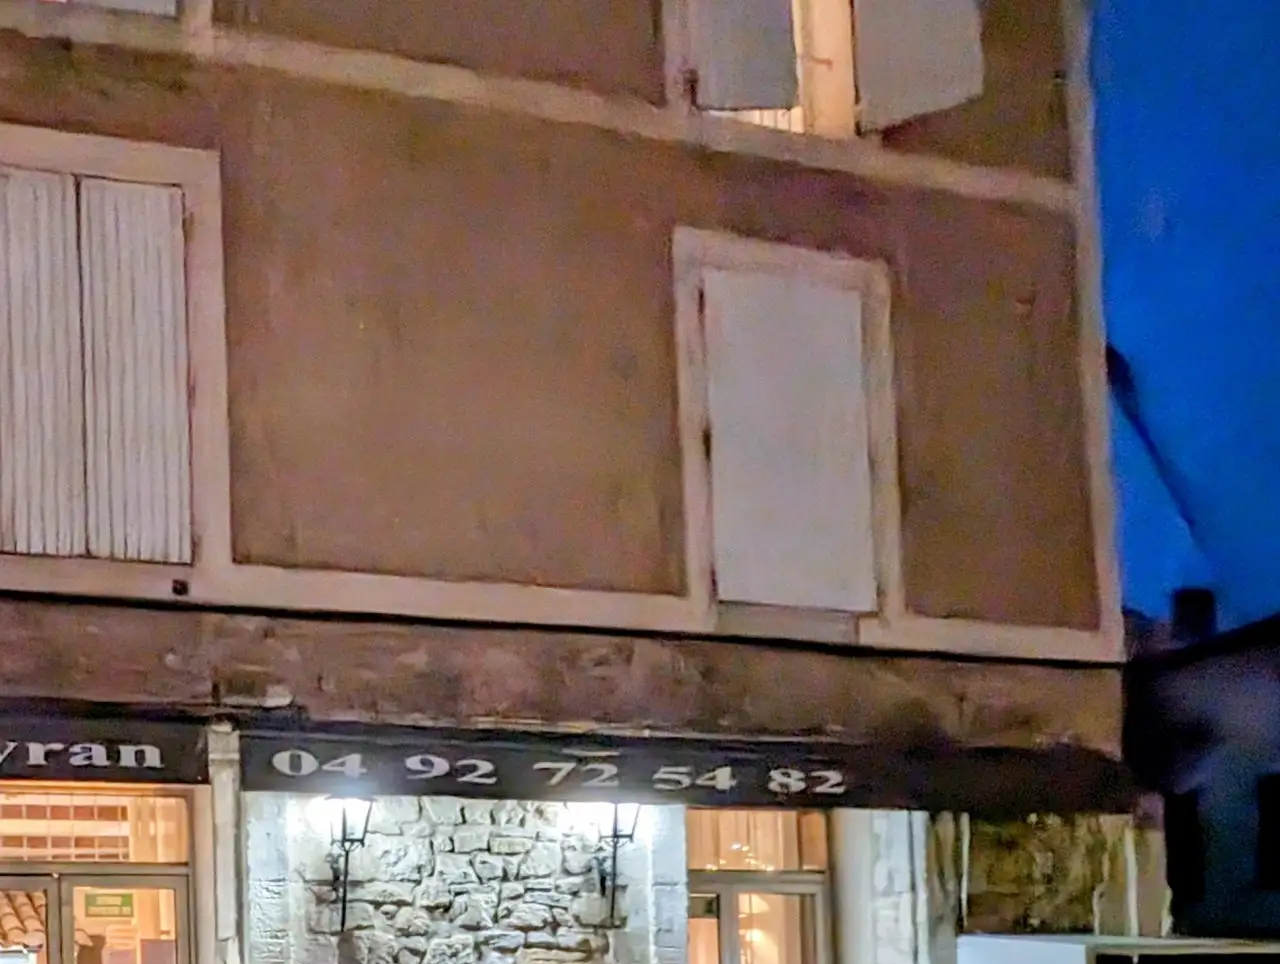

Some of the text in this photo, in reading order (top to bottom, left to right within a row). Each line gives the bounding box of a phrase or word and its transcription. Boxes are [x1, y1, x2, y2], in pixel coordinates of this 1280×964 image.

[271, 749, 847, 796] 04 92 72 54 82
